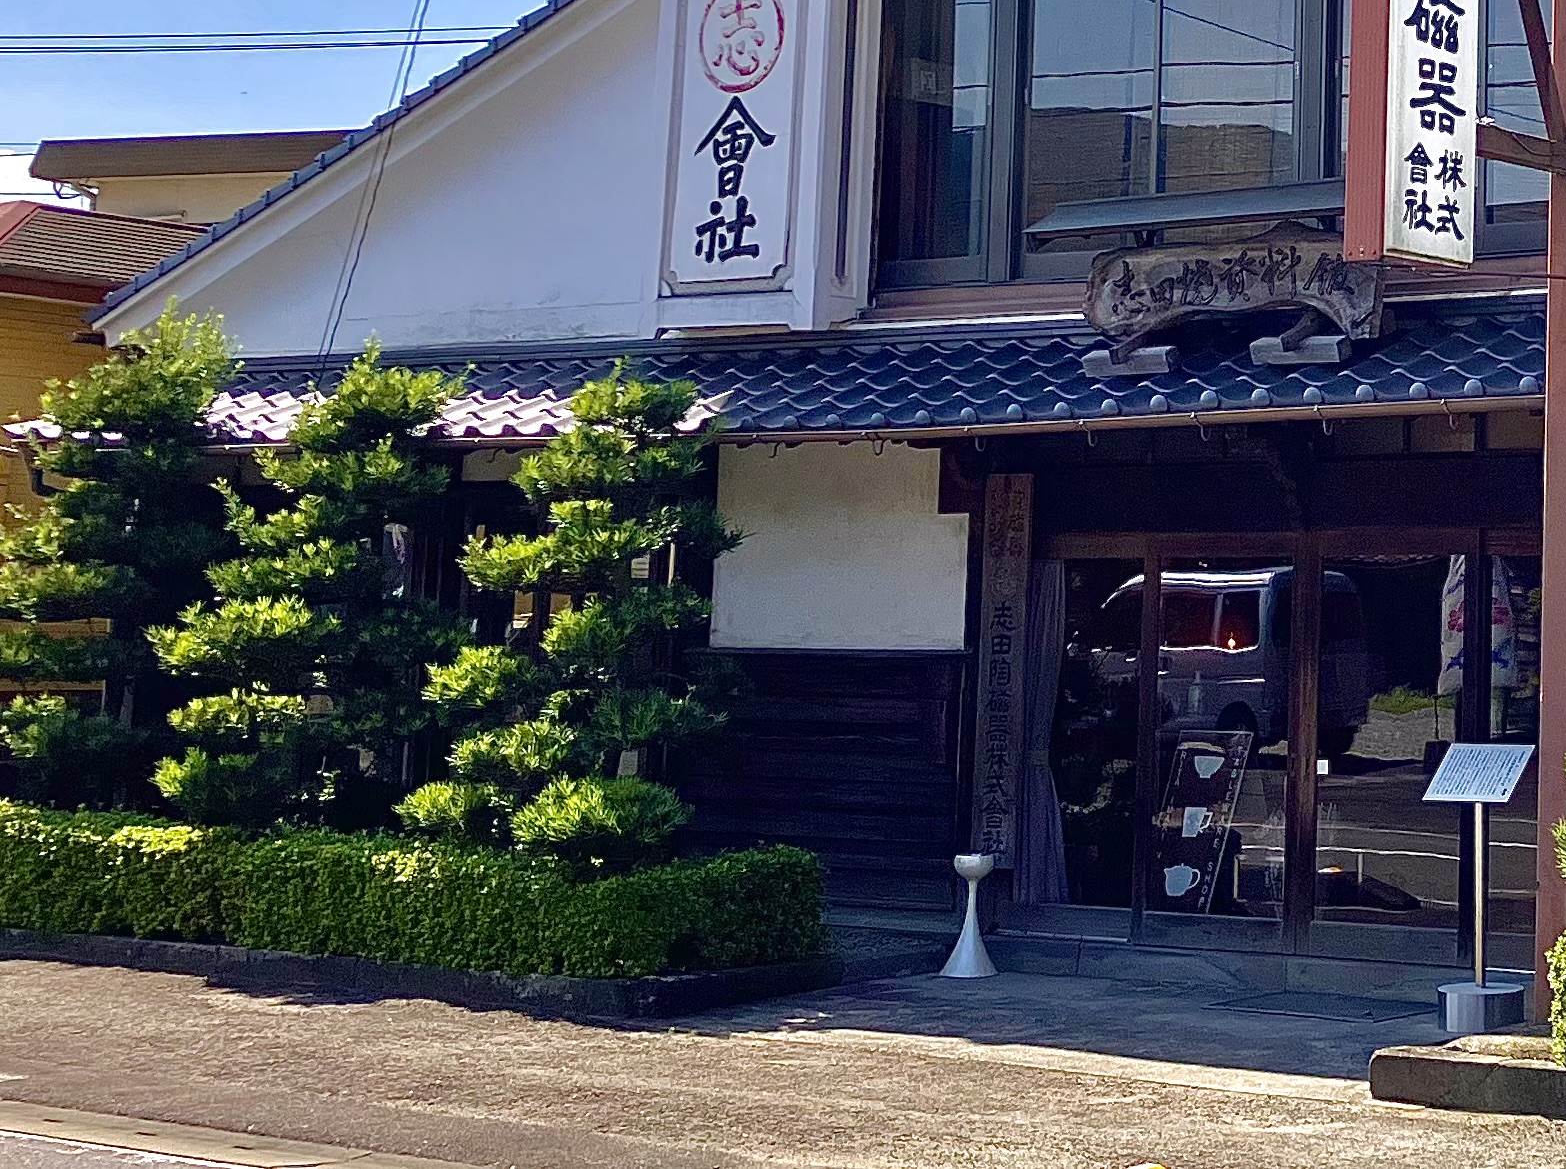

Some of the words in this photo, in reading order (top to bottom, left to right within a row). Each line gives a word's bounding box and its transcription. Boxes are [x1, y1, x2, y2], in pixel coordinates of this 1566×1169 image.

[694, 95, 777, 263] 會社
[1403, 142, 1436, 231] 會社
[1433, 149, 1467, 241] 株式
